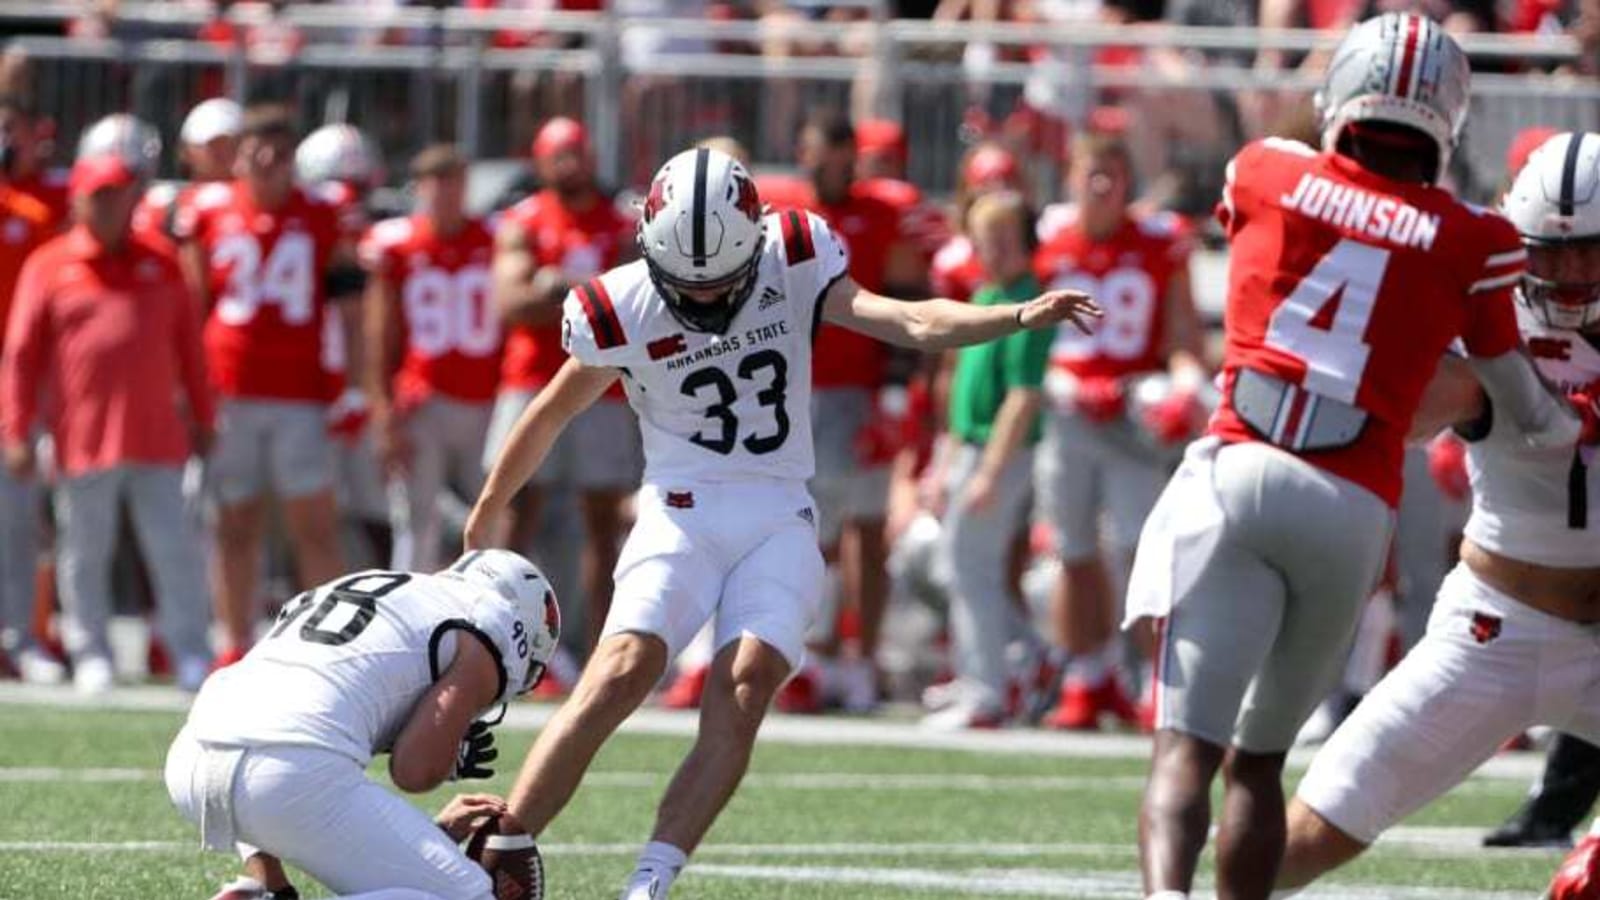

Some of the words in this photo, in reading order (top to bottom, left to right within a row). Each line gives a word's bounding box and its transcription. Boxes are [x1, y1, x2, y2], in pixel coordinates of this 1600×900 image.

[1280, 172, 1441, 250] JOHNSON
[211, 231, 314, 325] 34
[1263, 237, 1391, 404] 4
[746, 320, 790, 345] STATE
[680, 348, 790, 456] 33
